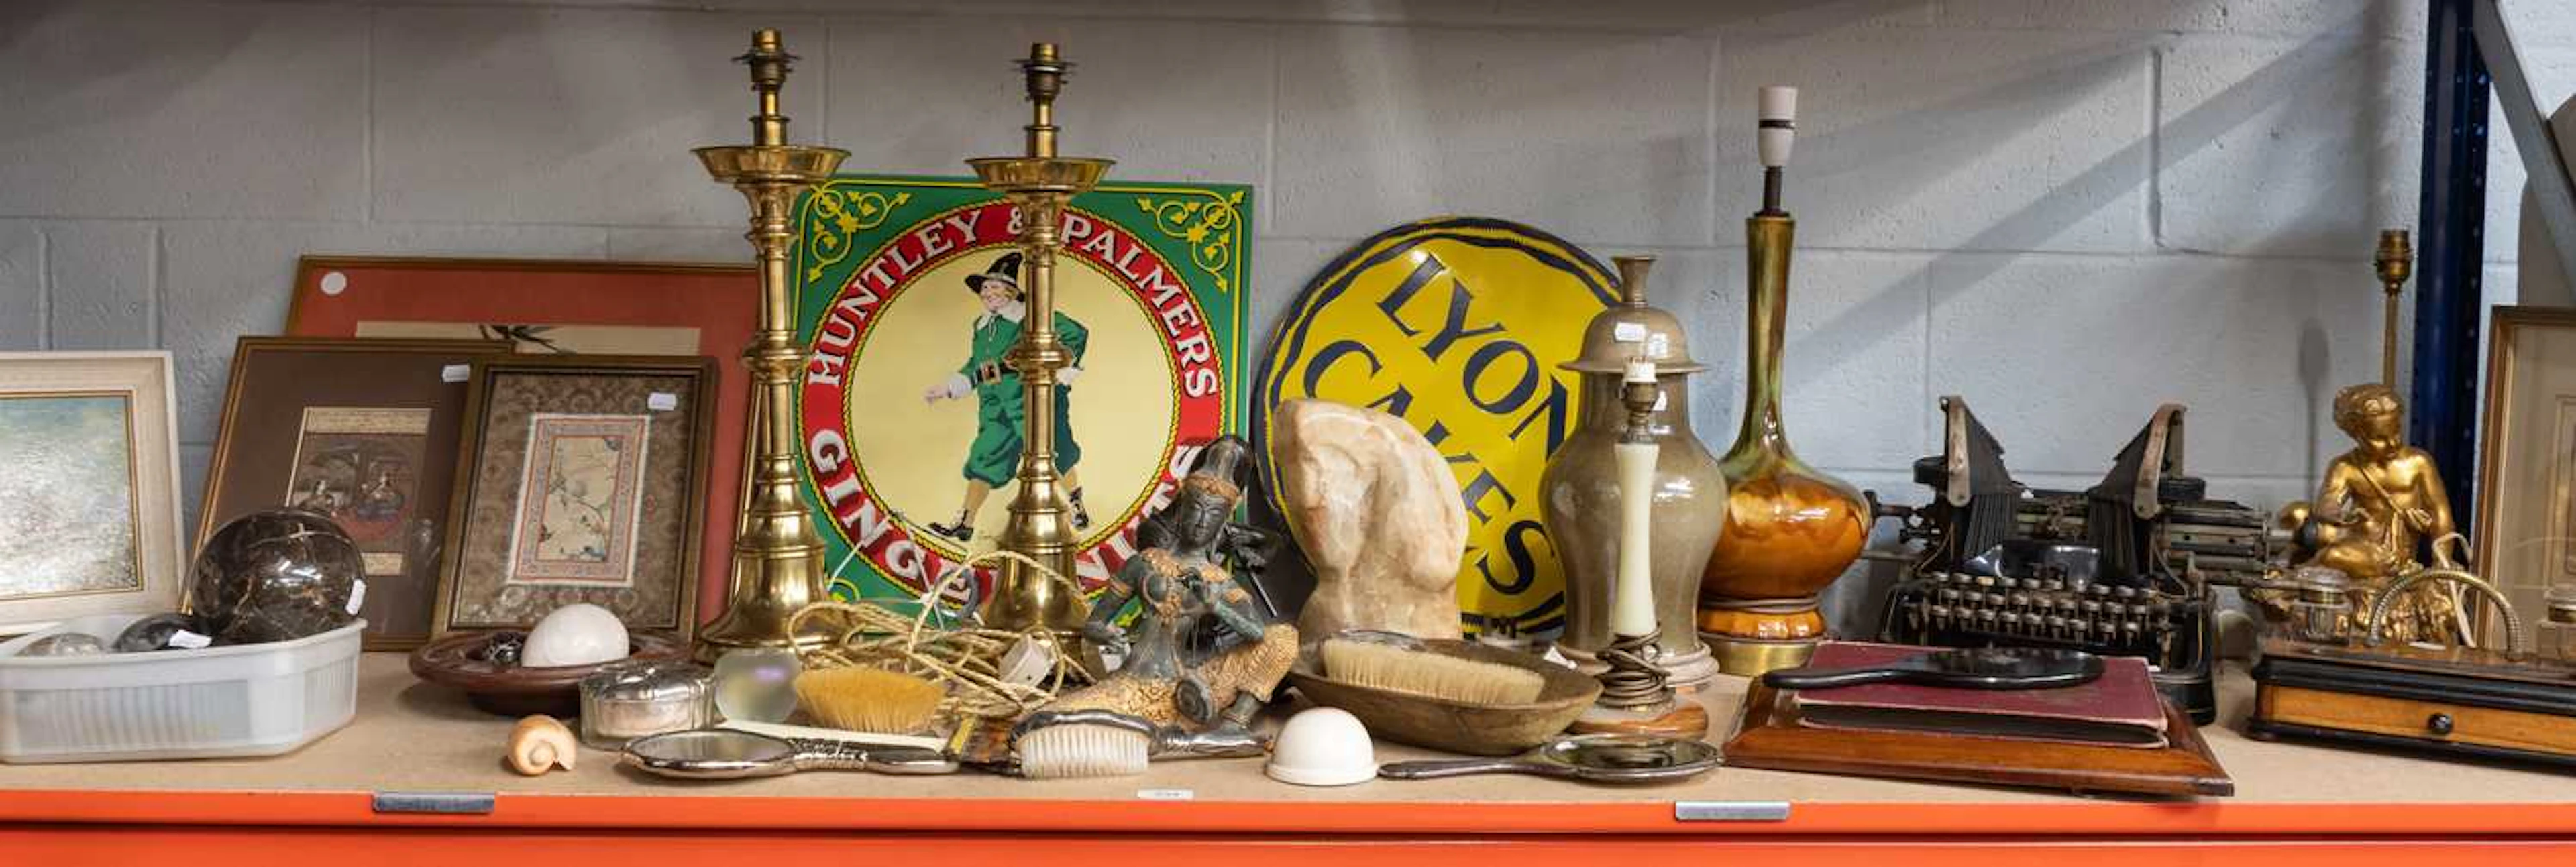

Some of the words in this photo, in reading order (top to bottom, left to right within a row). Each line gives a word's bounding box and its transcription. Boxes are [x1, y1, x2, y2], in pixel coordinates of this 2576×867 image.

[808, 208, 984, 388] HUNTLEY
[1007, 205, 1024, 235] &
[1060, 211, 1217, 399] PALMERS
[810, 429, 998, 602] GINGE
